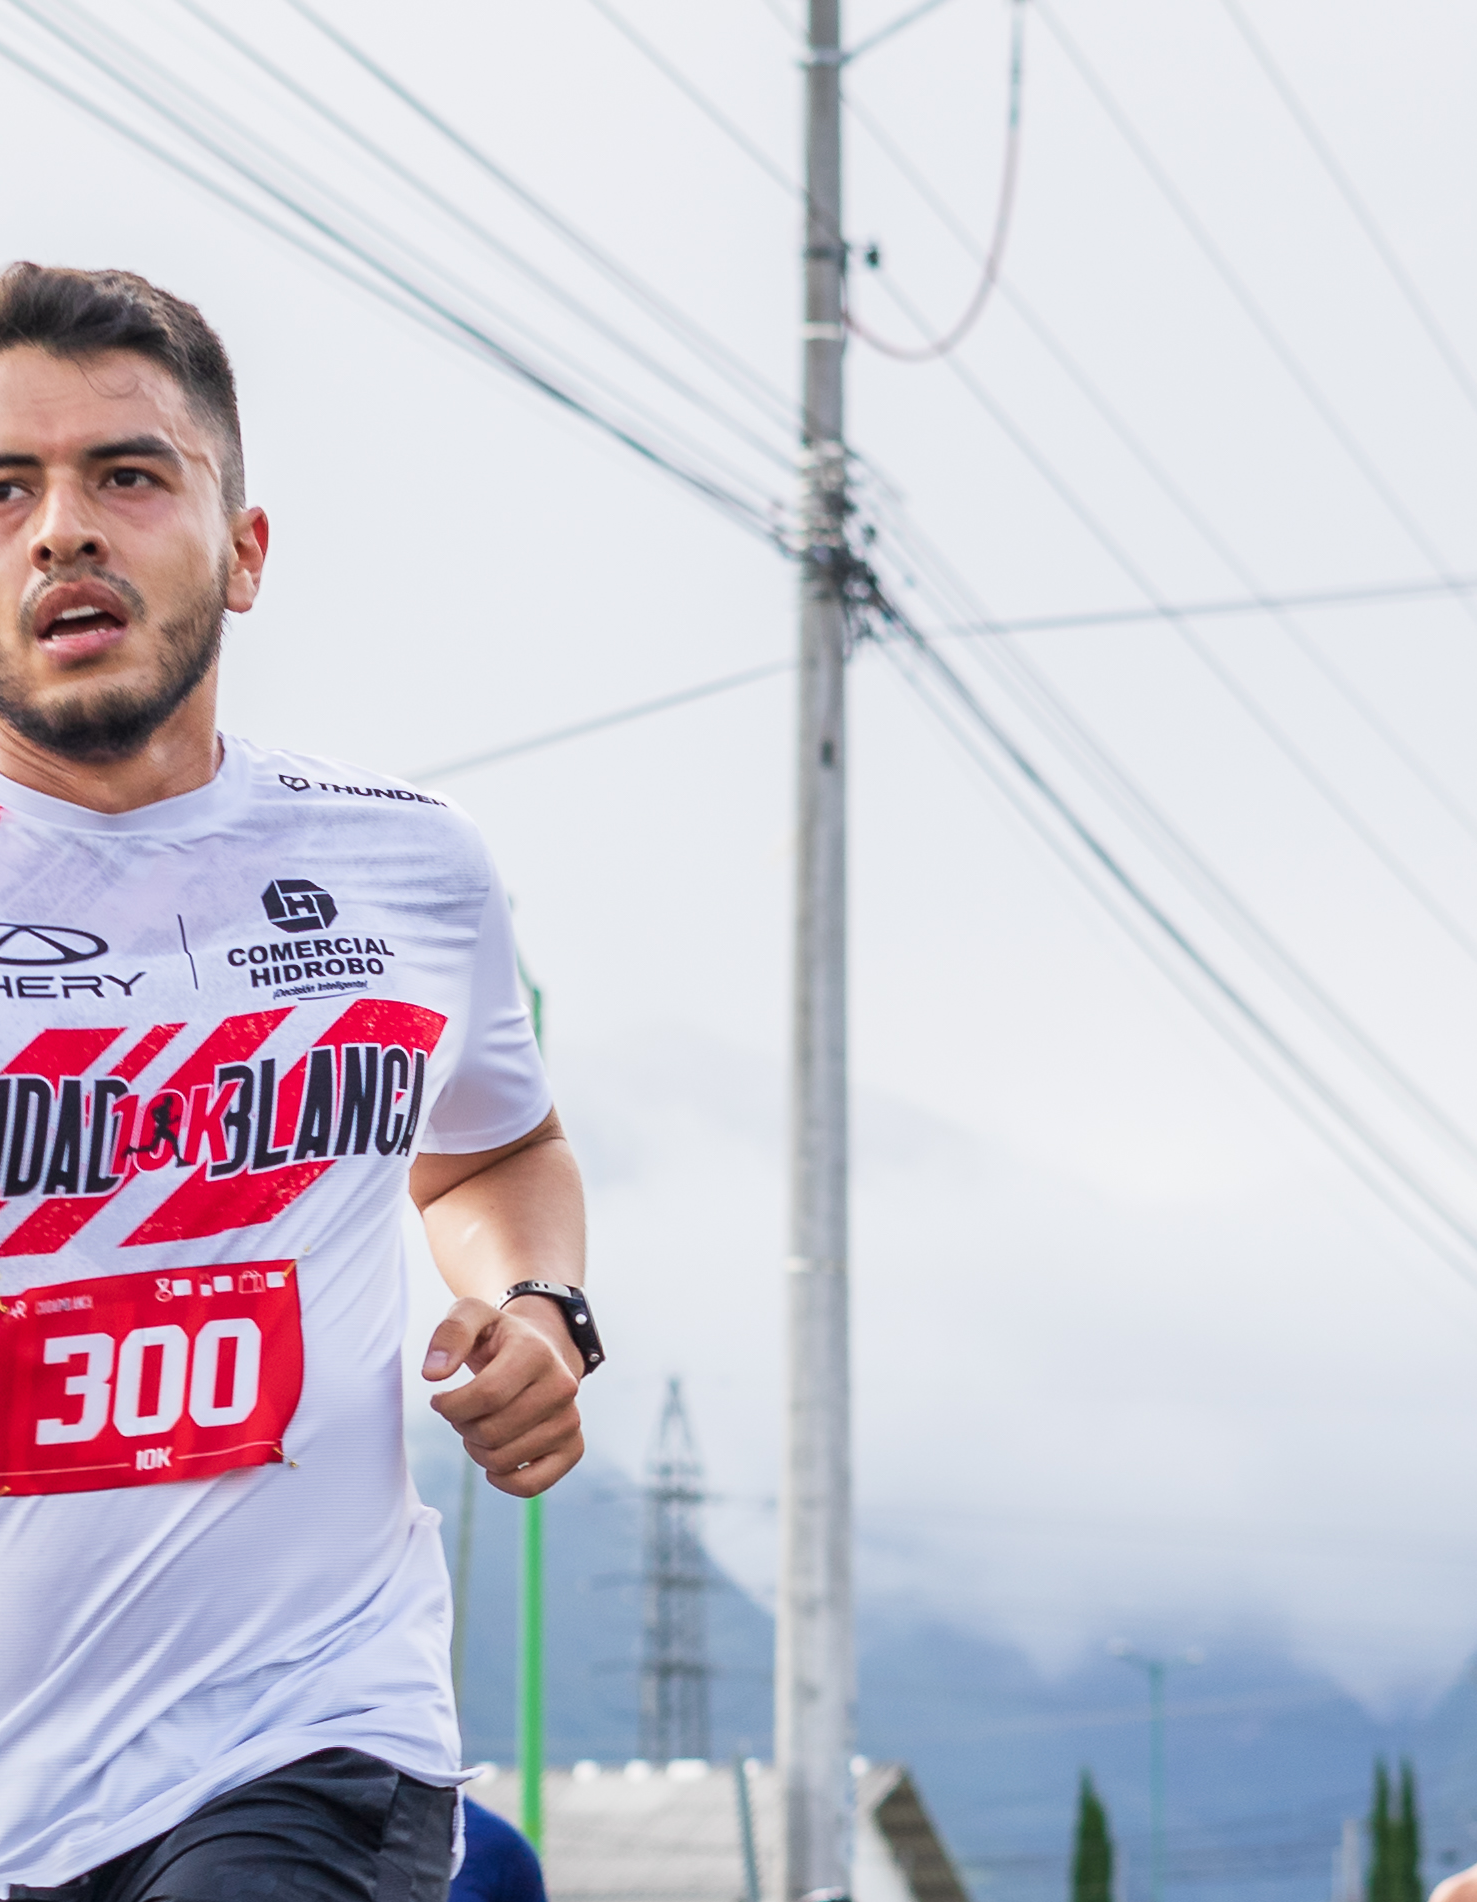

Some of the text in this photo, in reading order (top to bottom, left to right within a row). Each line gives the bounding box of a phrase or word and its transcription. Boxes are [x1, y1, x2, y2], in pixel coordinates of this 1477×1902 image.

[227, 937, 395, 967] COMERCIAL
[250, 957, 385, 988] HIDROBO
[35, 1317, 262, 1446] 300
[135, 1445, 174, 1471] 10K
